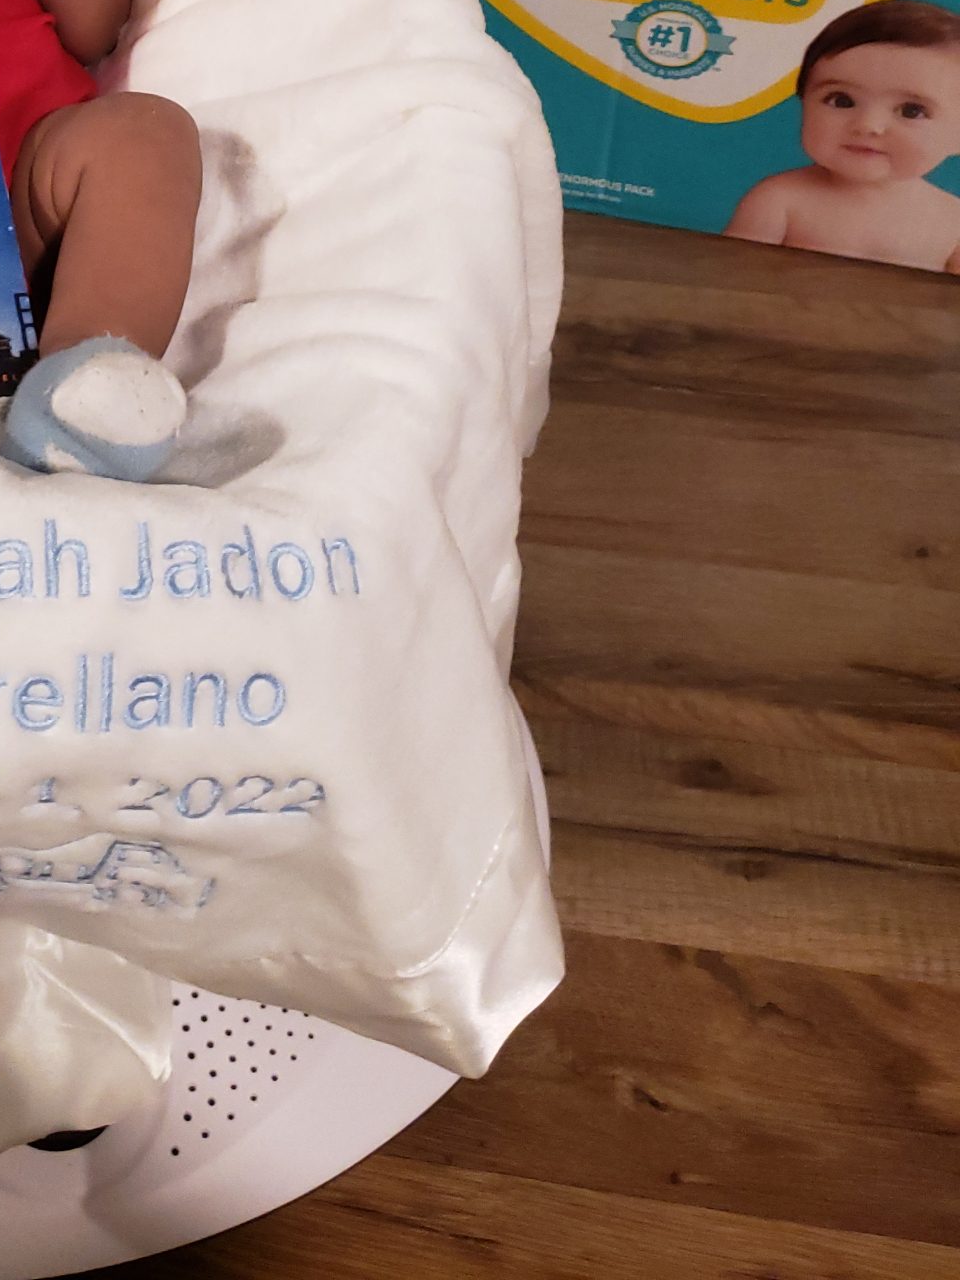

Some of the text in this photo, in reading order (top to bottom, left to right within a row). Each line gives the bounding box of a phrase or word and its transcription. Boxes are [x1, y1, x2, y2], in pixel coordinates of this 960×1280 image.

[648, 24, 691, 52] #1
[119, 521, 361, 602] Jadon
[119, 775, 326, 819] 2022
